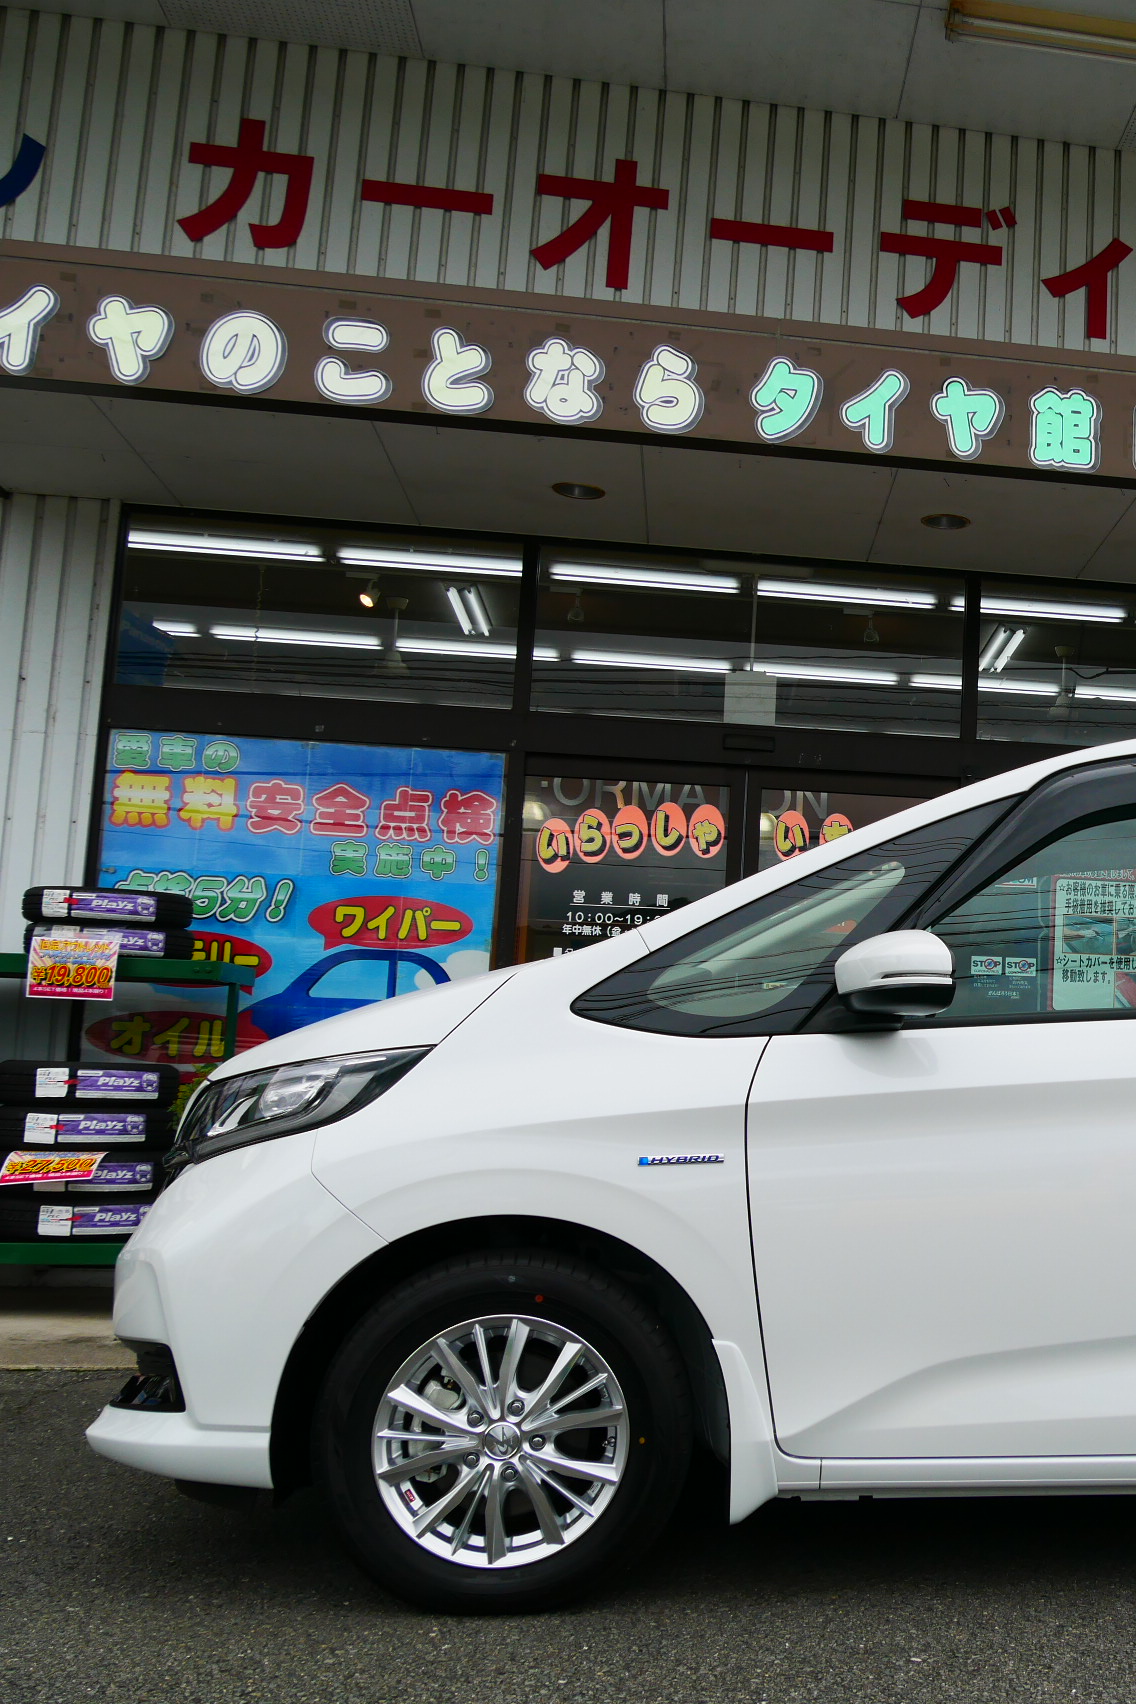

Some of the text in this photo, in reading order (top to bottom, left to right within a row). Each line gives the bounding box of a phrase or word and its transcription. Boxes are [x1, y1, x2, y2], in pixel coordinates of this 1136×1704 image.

[112, 733, 241, 772] 愛車の
[109, 770, 498, 845] 無料安全点検
[329, 840, 491, 881] 実施中!
[572, 889, 669, 907] 営業時間
[334, 905, 462, 941] ワイパー
[566, 911, 661, 925] 10:00~19:
[972, 959, 1001, 970] STOP
[1006, 960, 1035, 971] STOP
[32, 964, 113, 986] ¥19,800
[110, 1015, 226, 1058] オイル
[97, 1076, 140, 1087] Playz
[79, 1120, 124, 1131] Playz
[7, 1157, 97, 1174] ¥27,500
[650, 1155, 720, 1165] HYBRID
[93, 1212, 138, 1223] Playz
